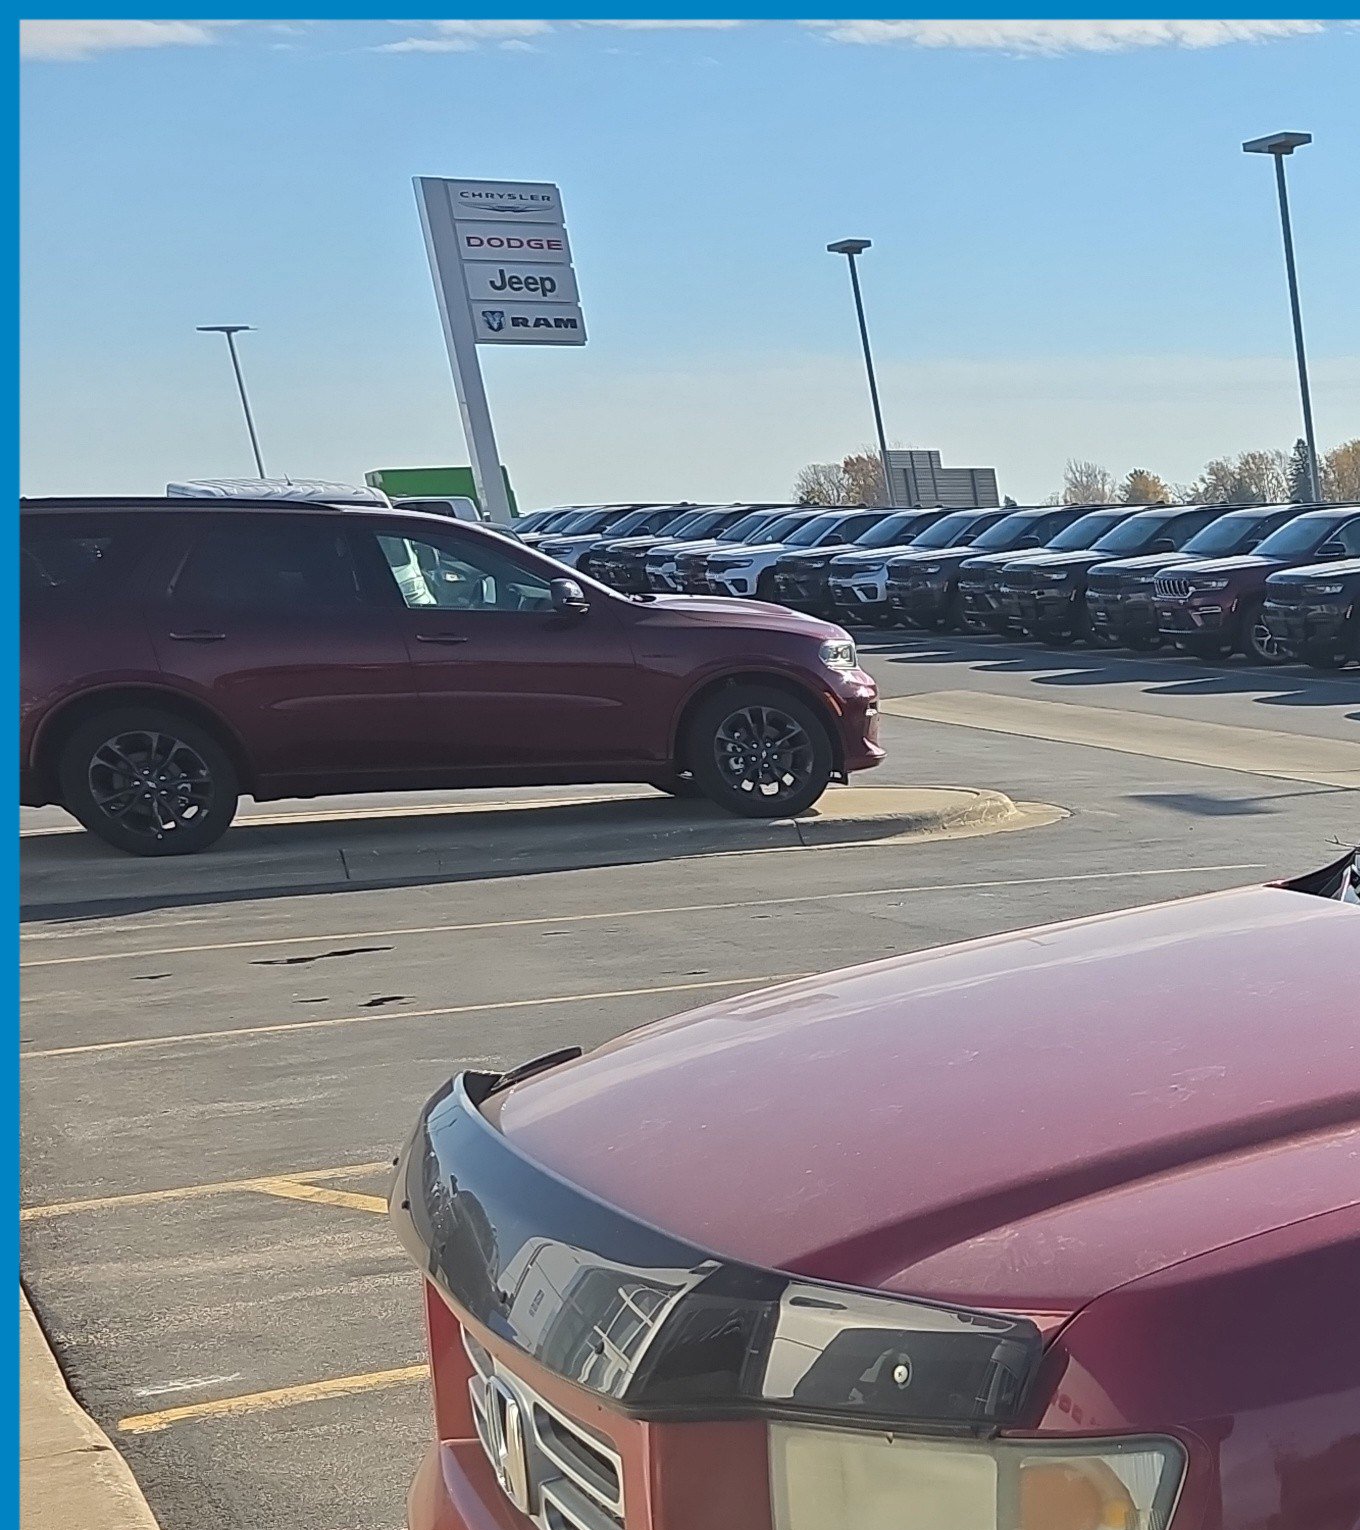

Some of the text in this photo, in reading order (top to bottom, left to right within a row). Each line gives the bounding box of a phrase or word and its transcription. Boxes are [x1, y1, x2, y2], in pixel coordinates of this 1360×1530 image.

[459, 191, 551, 202] CHRYSLER
[465, 236, 564, 251] DODGE
[489, 268, 557, 297] Jeep
[511, 316, 578, 329] RAM
